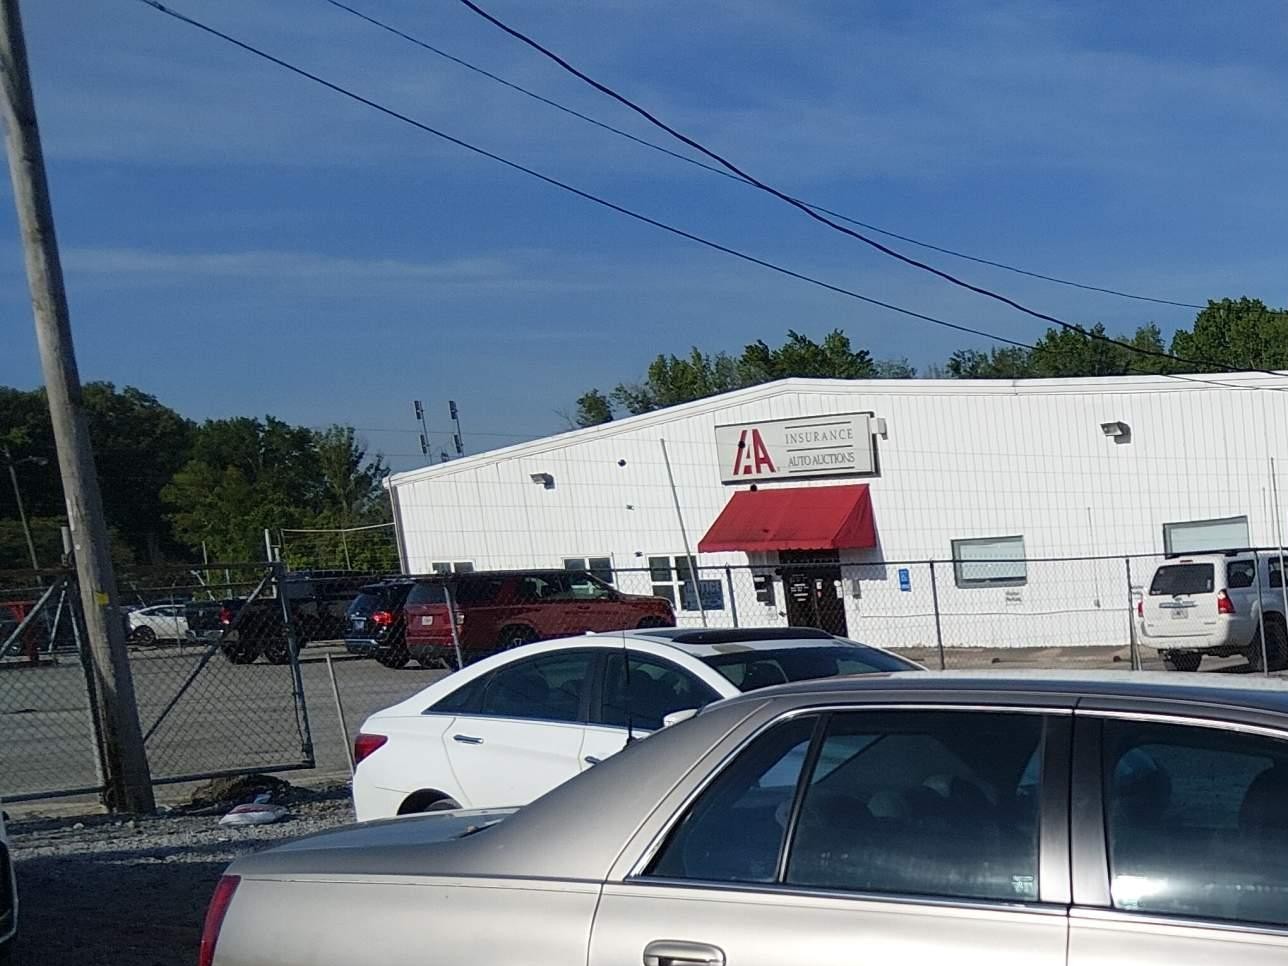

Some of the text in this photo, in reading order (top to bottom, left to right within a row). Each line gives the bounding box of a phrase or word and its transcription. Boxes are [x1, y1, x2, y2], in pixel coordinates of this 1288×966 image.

[785, 428, 853, 444] INSURANCE
[788, 451, 855, 466] AUTO AUCTIONS
[687, 582, 720, 592] NTICE
